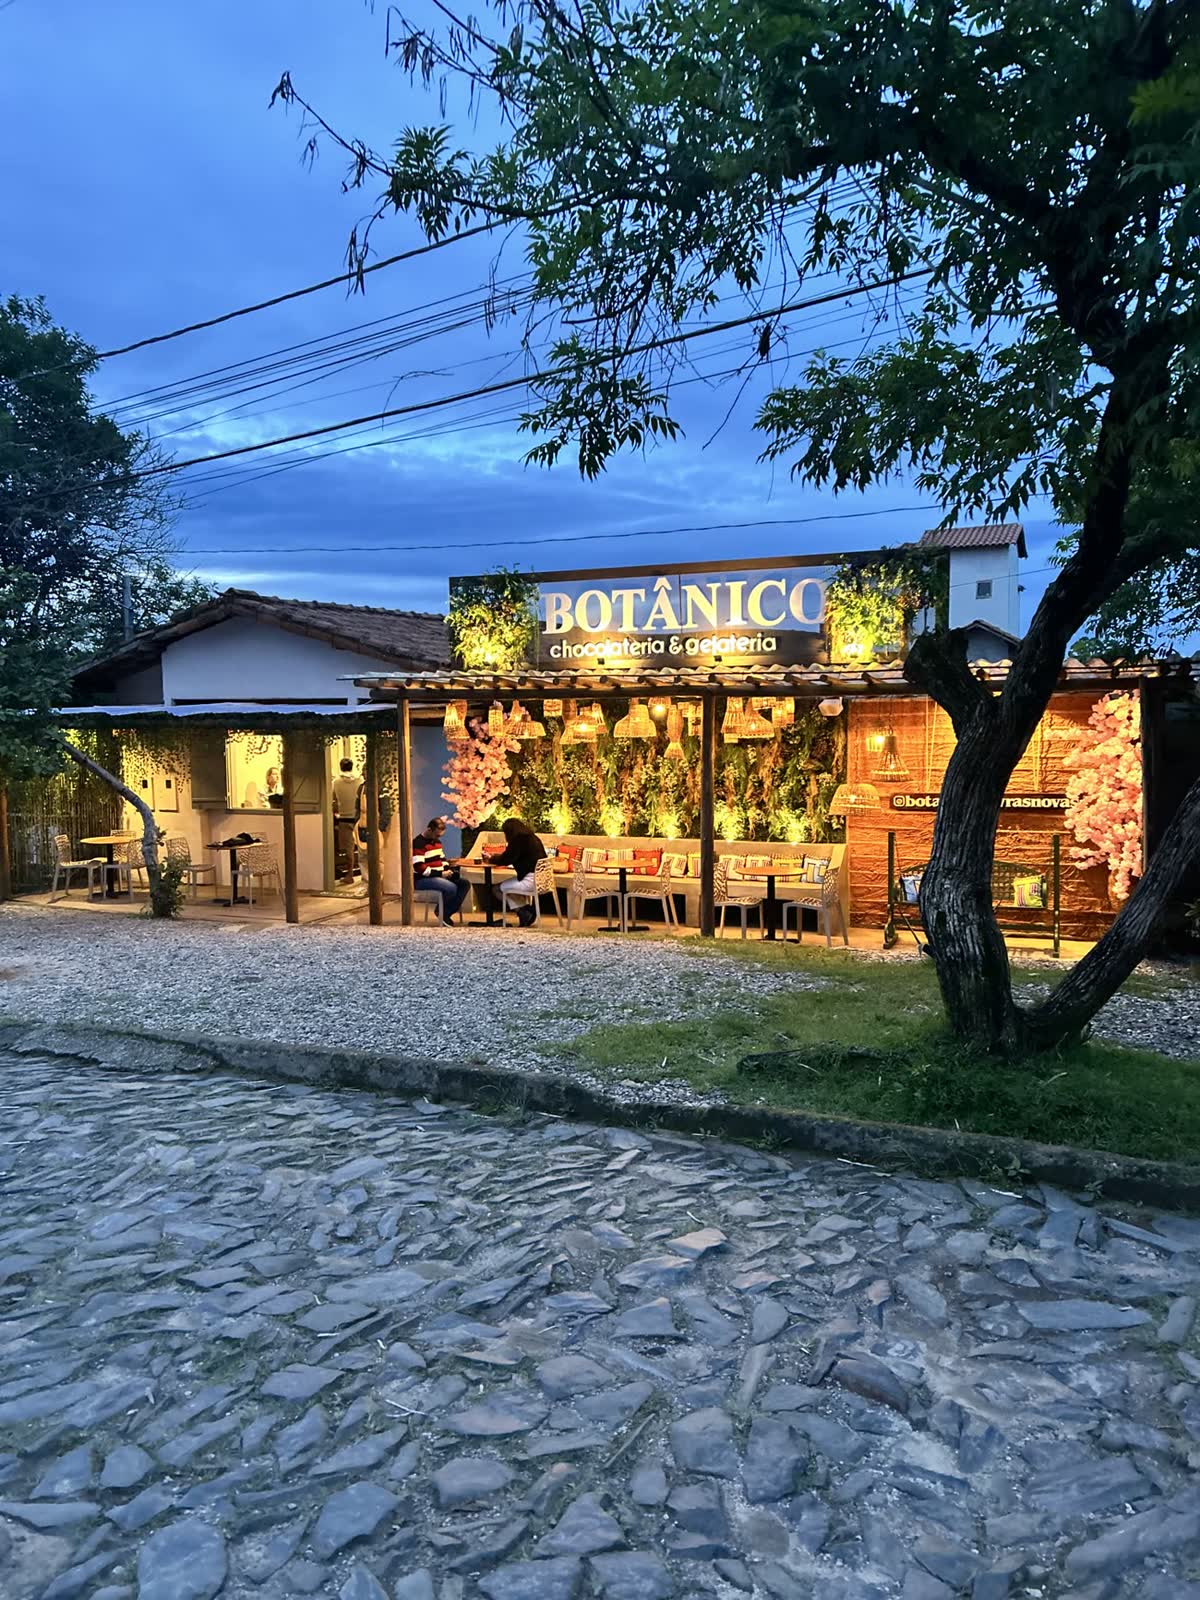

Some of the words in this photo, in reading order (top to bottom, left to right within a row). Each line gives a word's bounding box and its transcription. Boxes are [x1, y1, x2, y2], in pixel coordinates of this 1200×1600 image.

[542, 577, 827, 635] BOTÂNICO
[550, 638, 665, 658] chocolateria
[669, 636, 683, 654] &
[685, 633, 777, 655] gelateria
